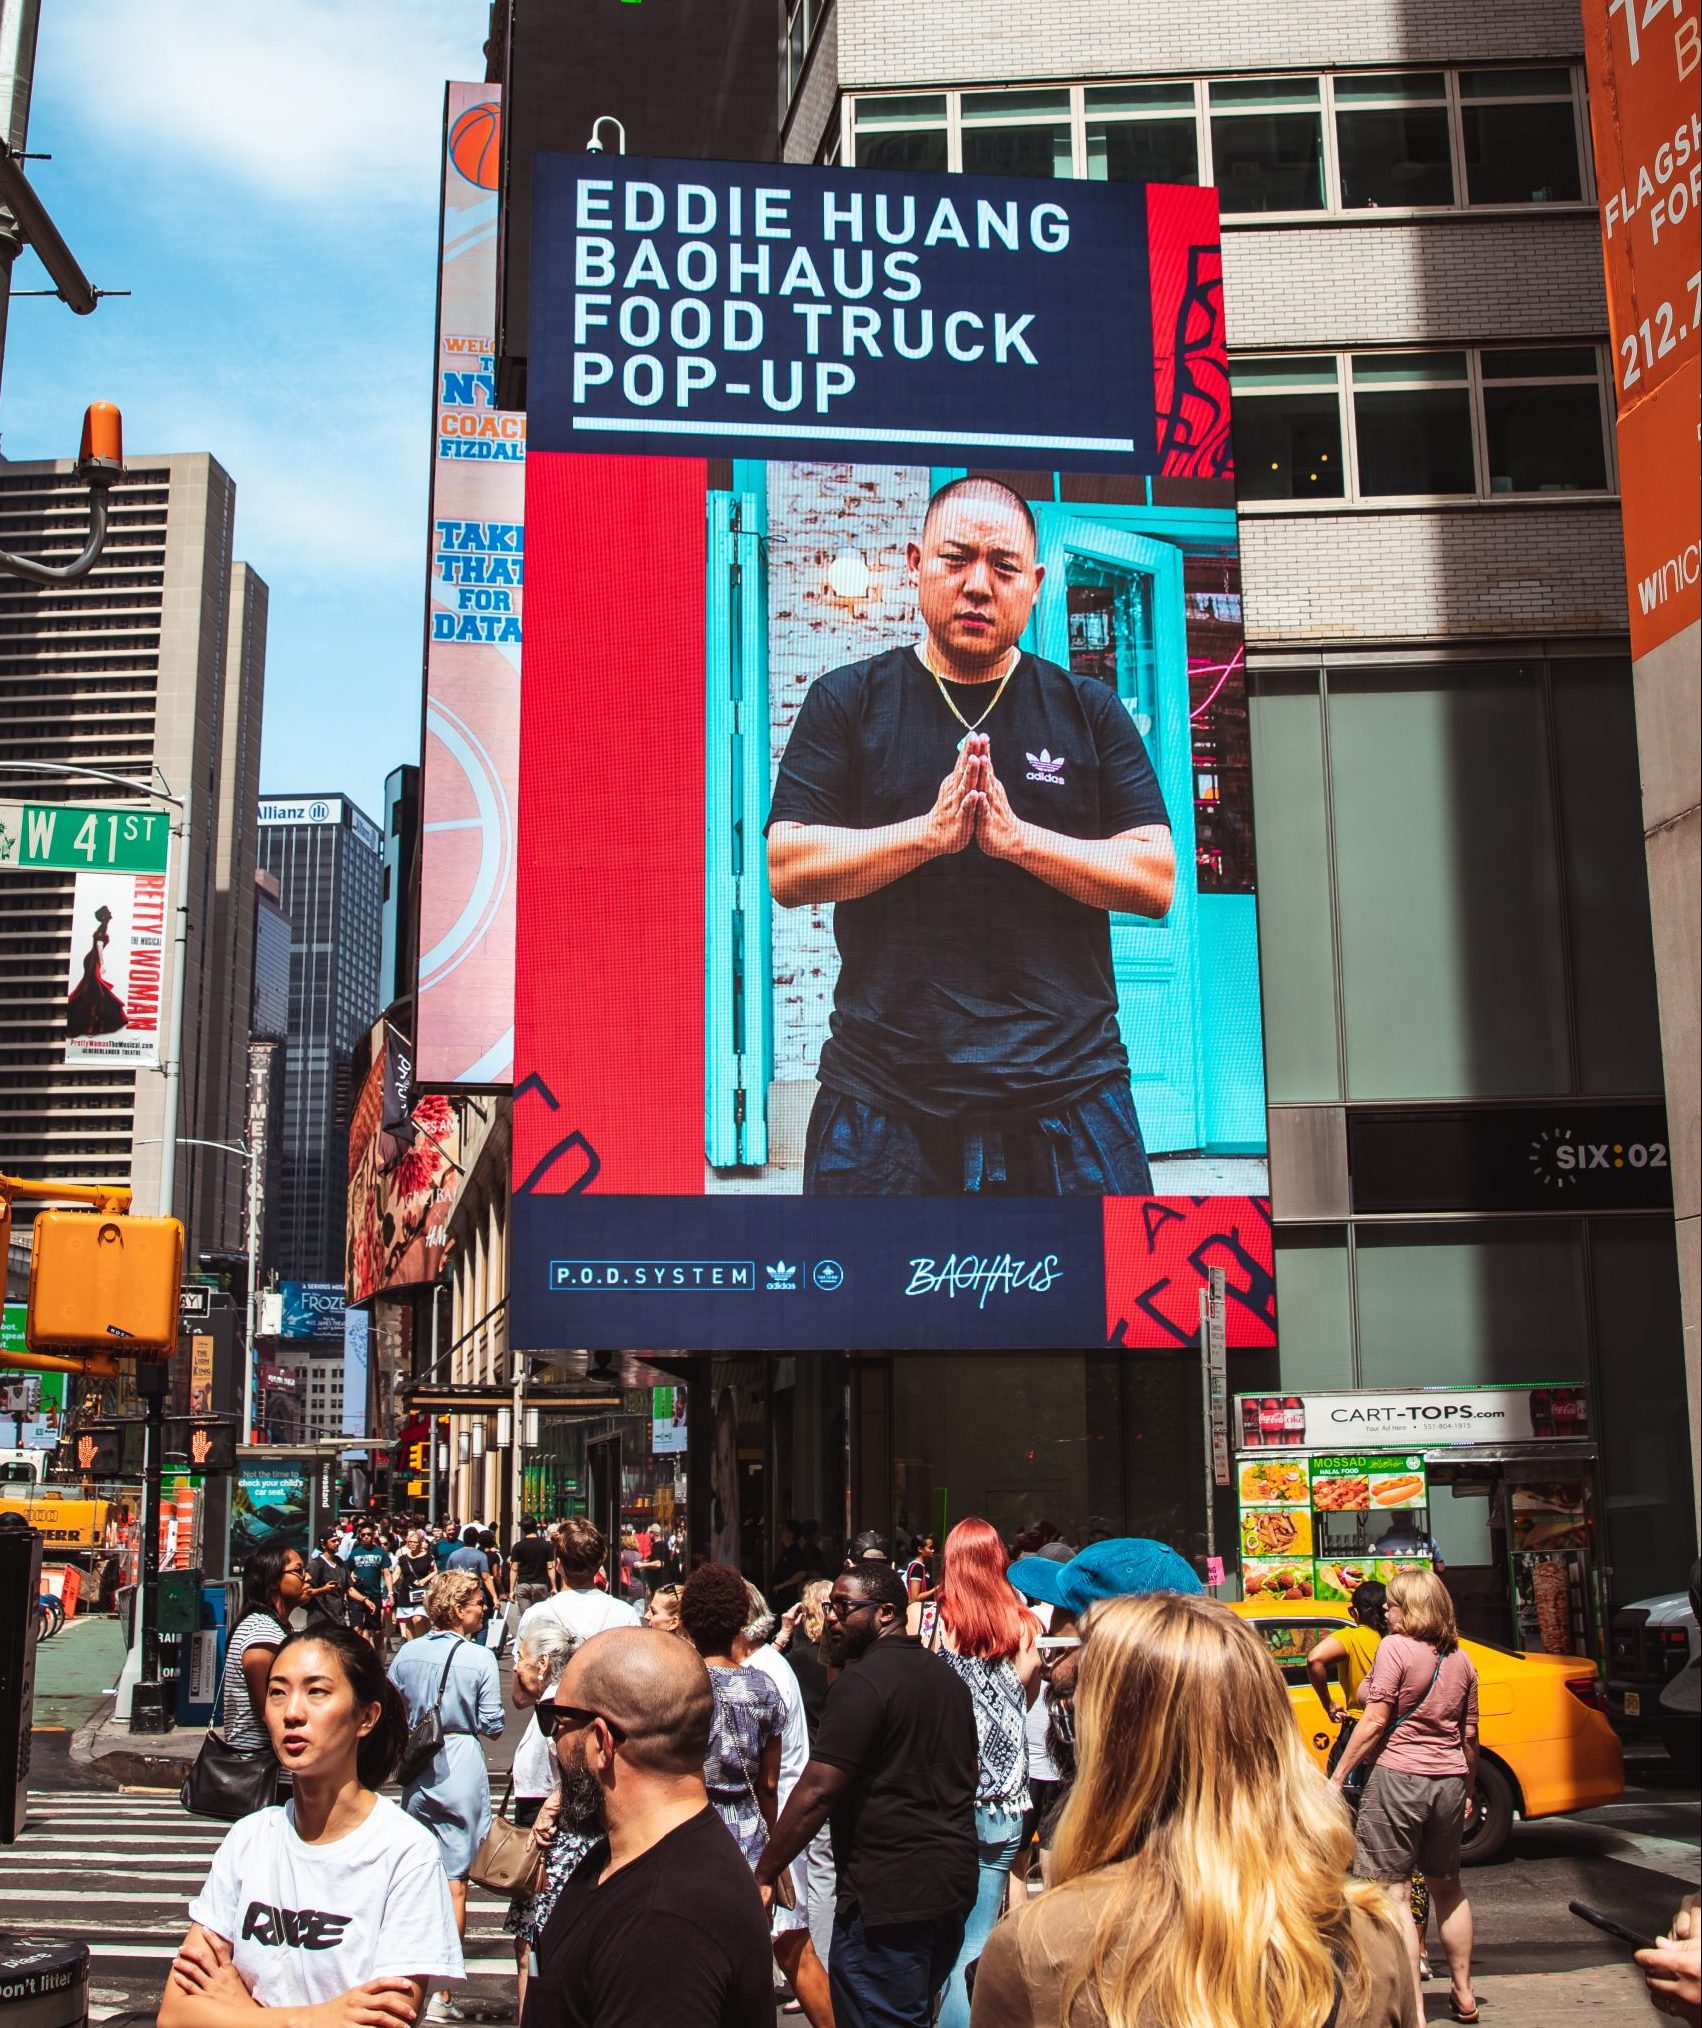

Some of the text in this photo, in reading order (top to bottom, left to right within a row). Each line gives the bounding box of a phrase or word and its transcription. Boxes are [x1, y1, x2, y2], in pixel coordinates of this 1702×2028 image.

[576, 179, 1070, 253] EDDIE HUANG
[574, 236, 922, 301] BAOHAUS
[573, 293, 1039, 365] FOOD TRUCK
[572, 351, 856, 414] POP-UP
[457, 588, 511, 612] FOR
[432, 612, 523, 643] DATA
[1026, 772, 1065, 785] adidas
[27, 810, 57, 860] W
[140, 936, 162, 947] MUSICAL
[125, 949, 162, 1031] WOMAN
[249, 1068, 268, 1155] TIMES
[1556, 1143, 1668, 1170] SIX:02
[766, 1281, 797, 1290] adidas
[904, 1253, 1064, 1310] BAOHAUS
[193, 1366, 211, 1377] KING
[1330, 1405, 1505, 1423] CART-TOPS.com
[1313, 1456, 1367, 1469] MOSSAD
[238, 1479, 304, 1488] check your child's
[268, 1488, 286, 1496] seat.
[40, 1972, 73, 1991] litter
